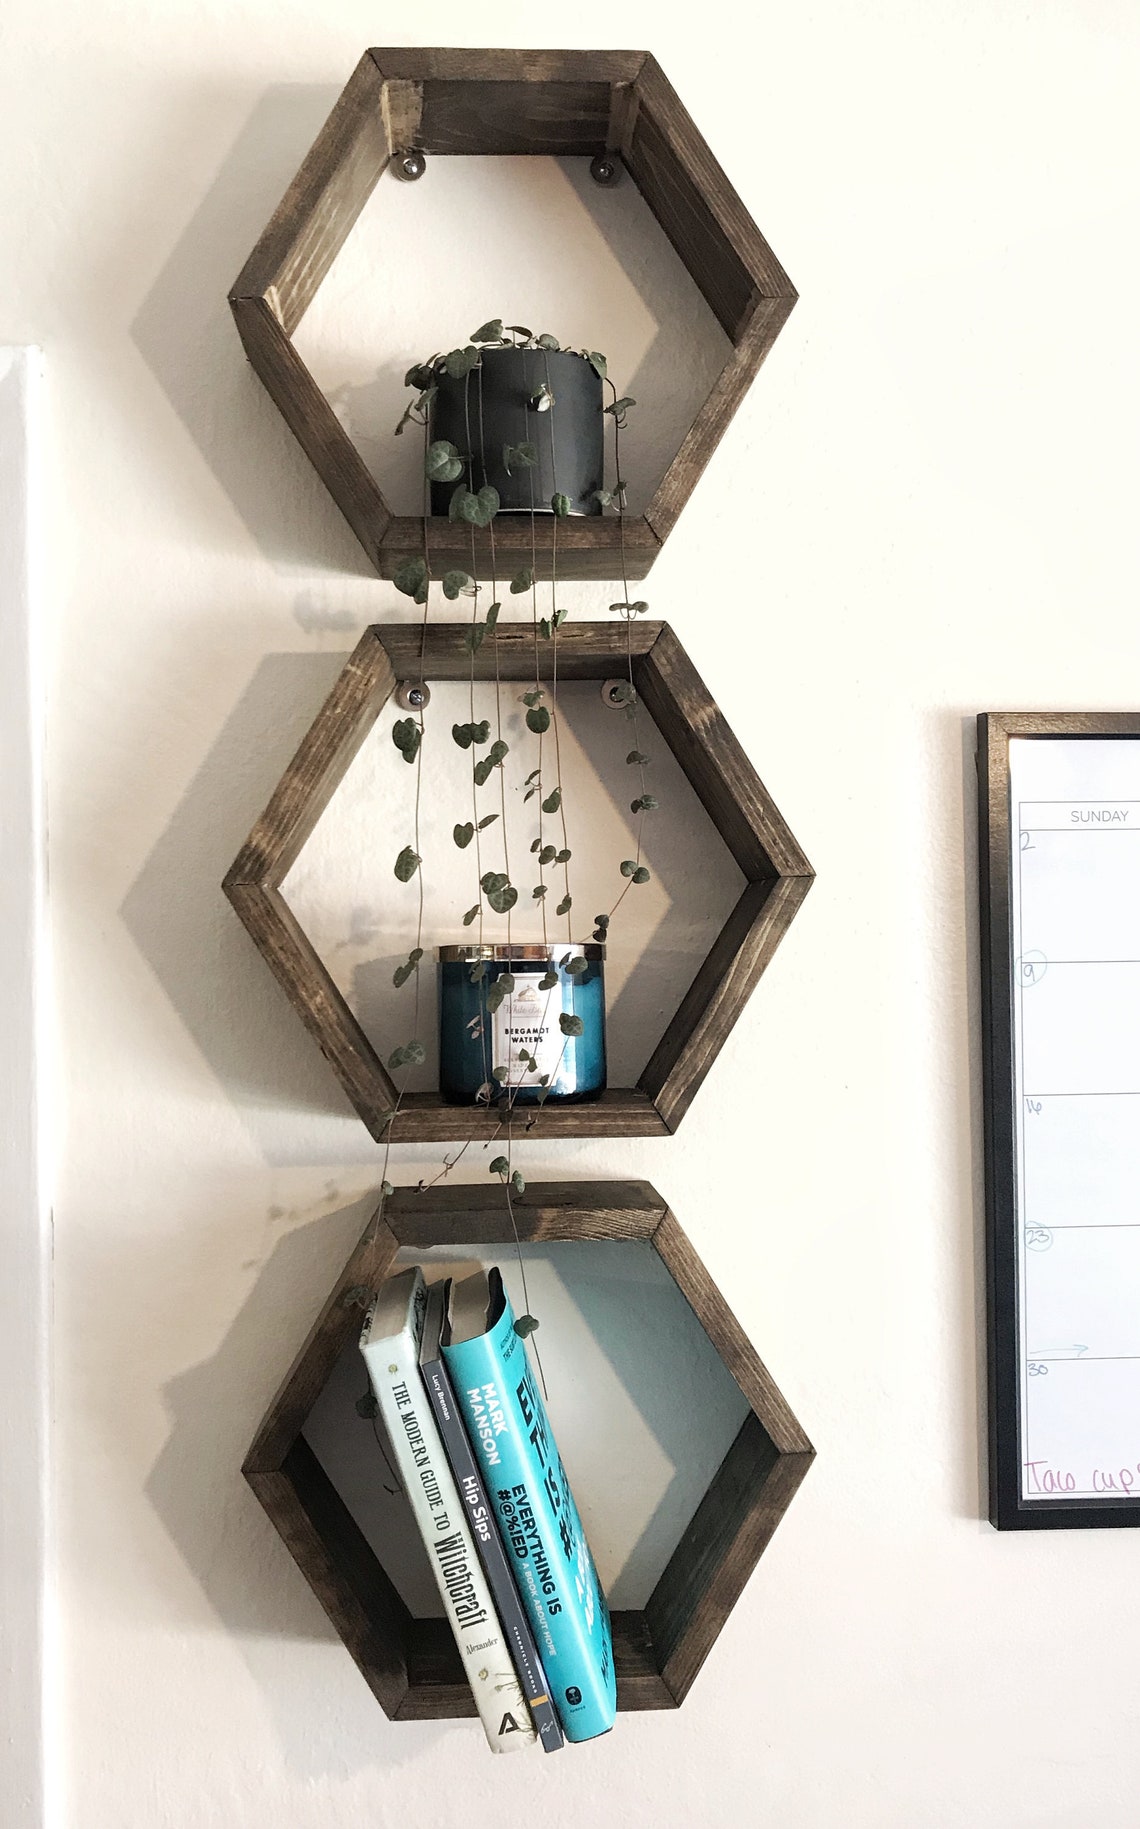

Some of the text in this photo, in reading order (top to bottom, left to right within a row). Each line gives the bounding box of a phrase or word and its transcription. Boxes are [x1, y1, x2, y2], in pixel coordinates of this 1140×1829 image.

[1070, 810, 1129, 823] SUNDAY
[1020, 831, 1036, 851] 2
[1023, 964, 1036, 982] 9
[504, 1027, 549, 1035] BERGAMOT
[1025, 1098, 1042, 1115] 16
[1026, 1229, 1050, 1245] 23
[1028, 1362, 1049, 1377] 30
[432, 1374, 451, 1421] Lucy Brennan
[481, 1382, 509, 1437] MARK
[466, 1388, 501, 1466] MANSON
[1023, 1460, 1075, 1493] Taco
[392, 1381, 488, 1630] THE MODERN GUIDE TO Witchcraft
[462, 1475, 491, 1542] Hip Sips
[511, 1483, 556, 1596] EVERYTHING
[546, 1597, 562, 1616] IS
[524, 1570, 538, 1598] BOOK
[533, 1598, 549, 1633] ABOUT
[542, 1630, 557, 1656] HOPE
[466, 1637, 499, 1656] Alexander
